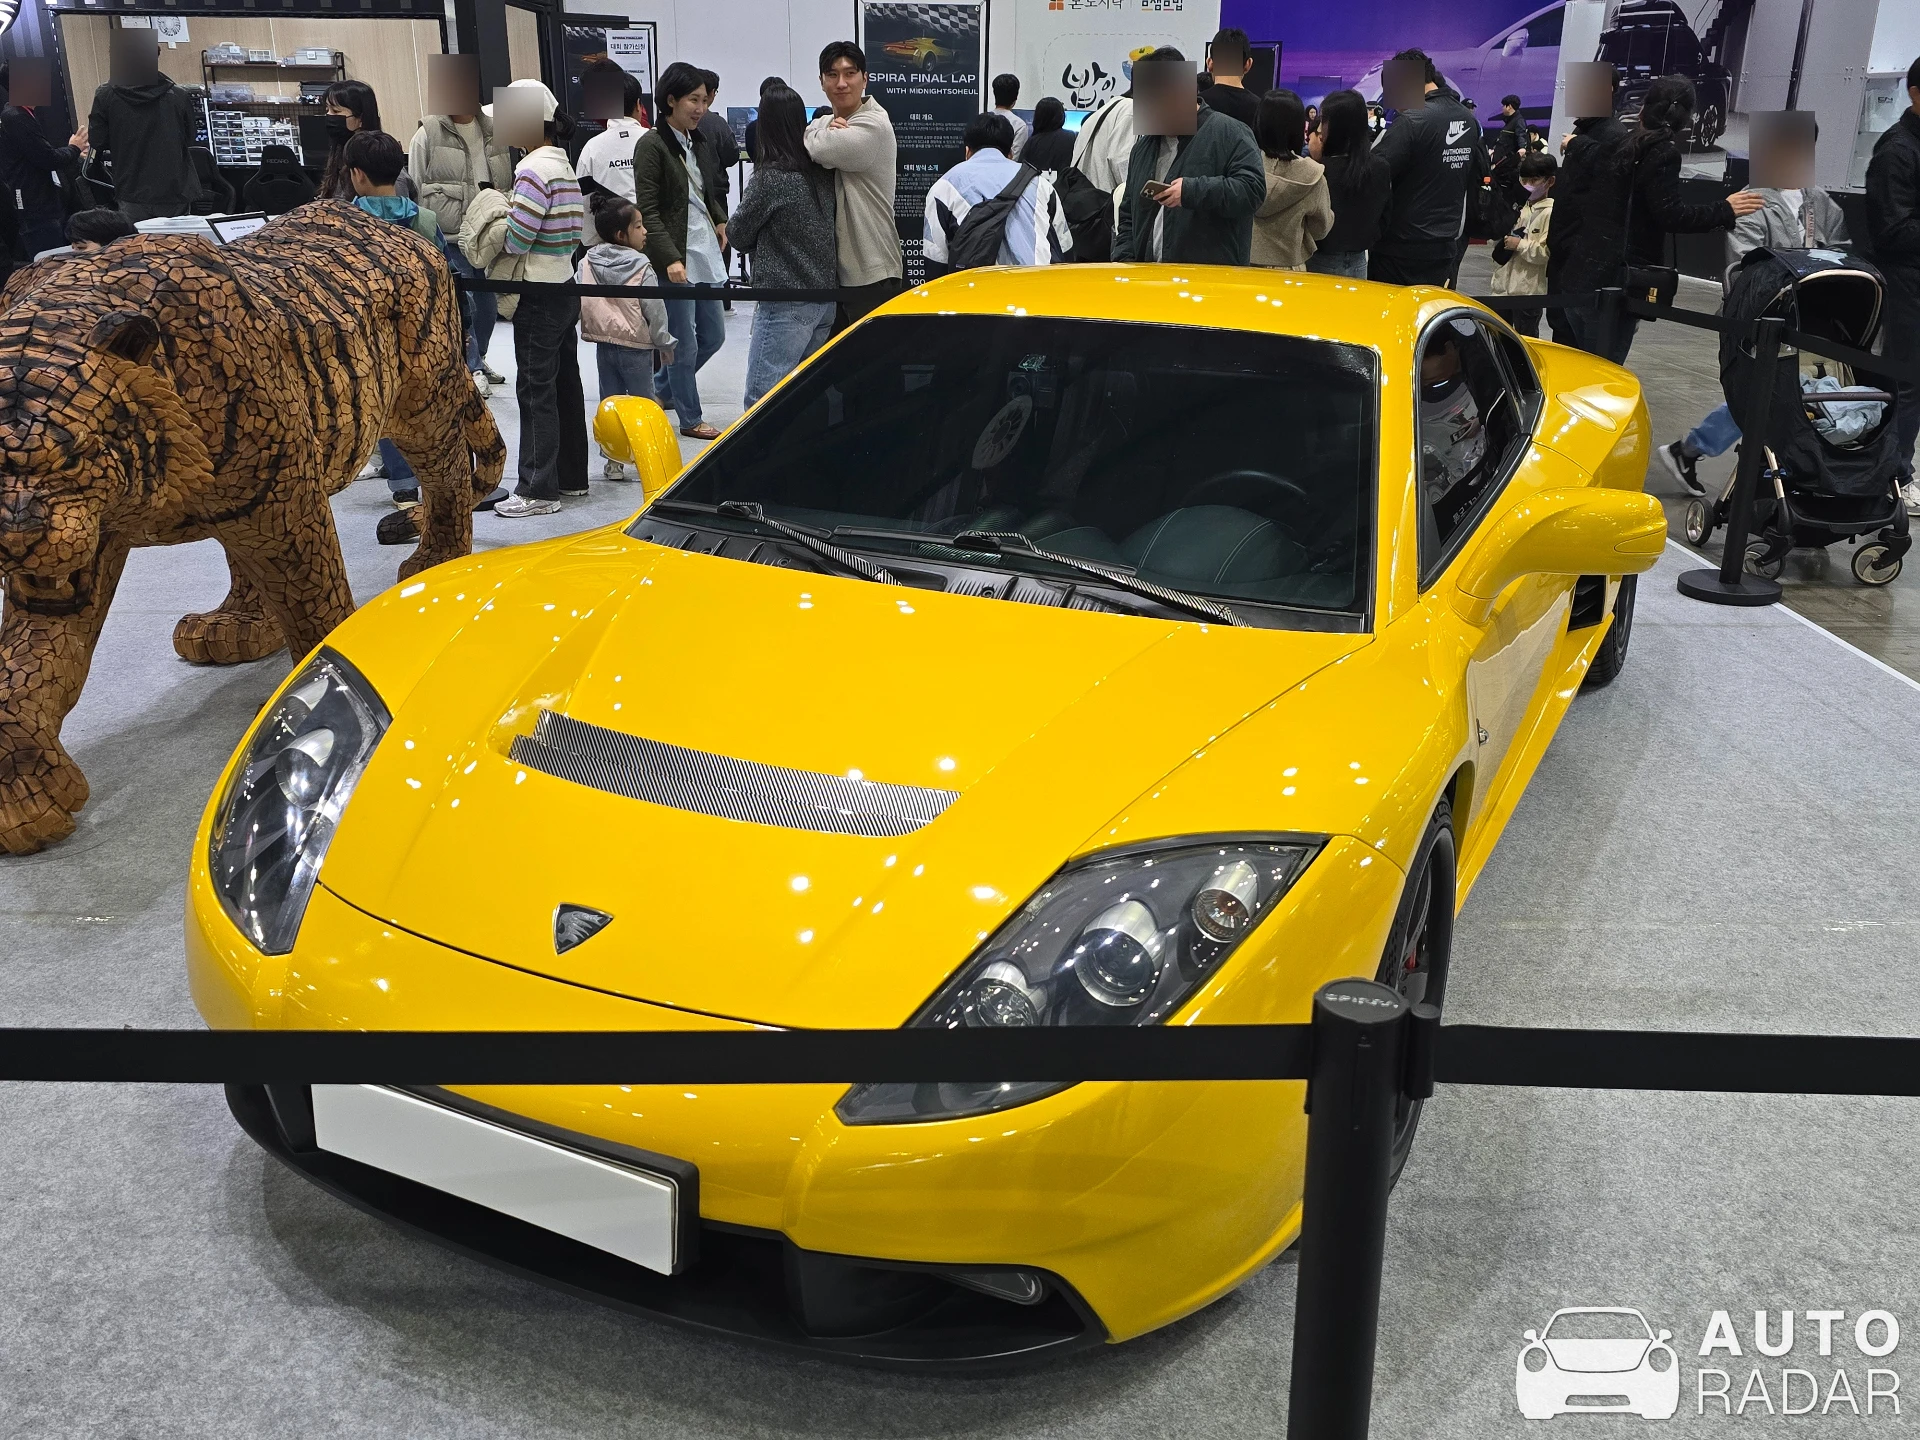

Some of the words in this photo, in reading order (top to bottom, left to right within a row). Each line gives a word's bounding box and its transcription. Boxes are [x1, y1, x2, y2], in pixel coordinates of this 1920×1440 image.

[868, 73, 907, 83] SPIRA
[910, 73, 948, 84] FINAL
[951, 74, 976, 84] LAP
[886, 87, 907, 95] WITH
[1449, 120, 1465, 135] NIKE
[1442, 147, 1472, 156] AUTHORIZED
[1442, 154, 1470, 163] PERSONNEL
[1450, 161, 1464, 169] ONLY
